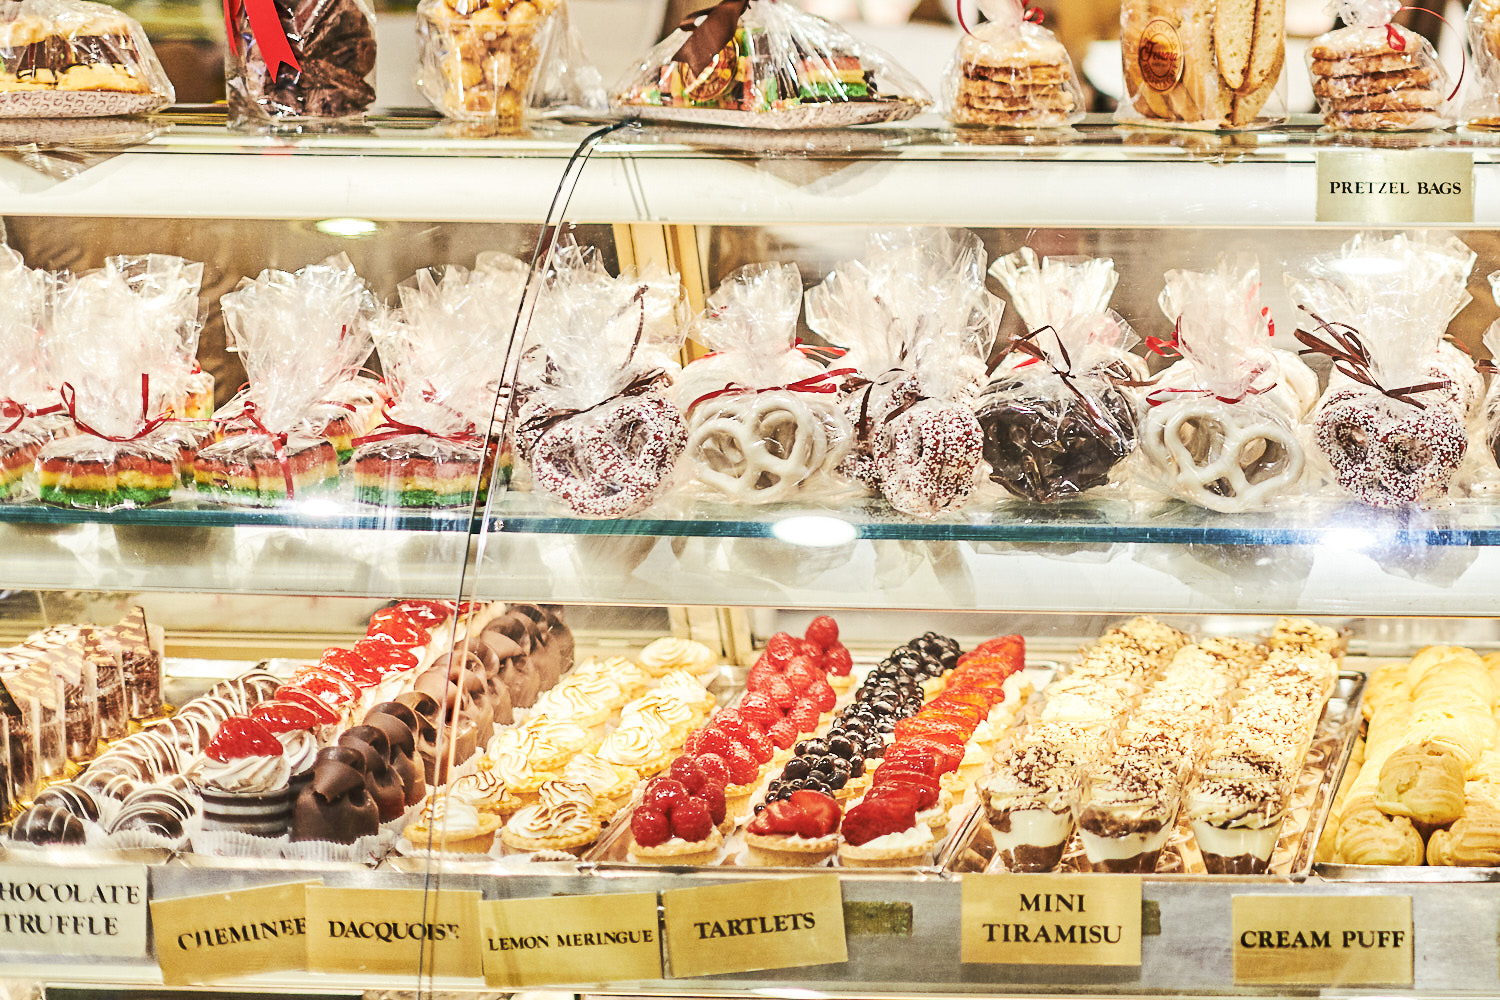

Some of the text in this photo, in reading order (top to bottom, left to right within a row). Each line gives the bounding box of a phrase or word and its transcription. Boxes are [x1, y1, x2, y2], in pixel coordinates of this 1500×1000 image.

[1330, 181, 1462, 195] PRETZEL BAGS
[0, 882, 139, 904] HOCOLATE
[1019, 893, 1086, 912] MINI
[0, 913, 118, 936] TRUFFLE
[177, 916, 306, 951] CHEMINEE
[694, 911, 816, 940] TARTLETS
[982, 923, 1122, 944] TIRAMISU
[489, 930, 653, 951] LEMON MERINGUE
[1240, 930, 1406, 949] CREAM PUFF
